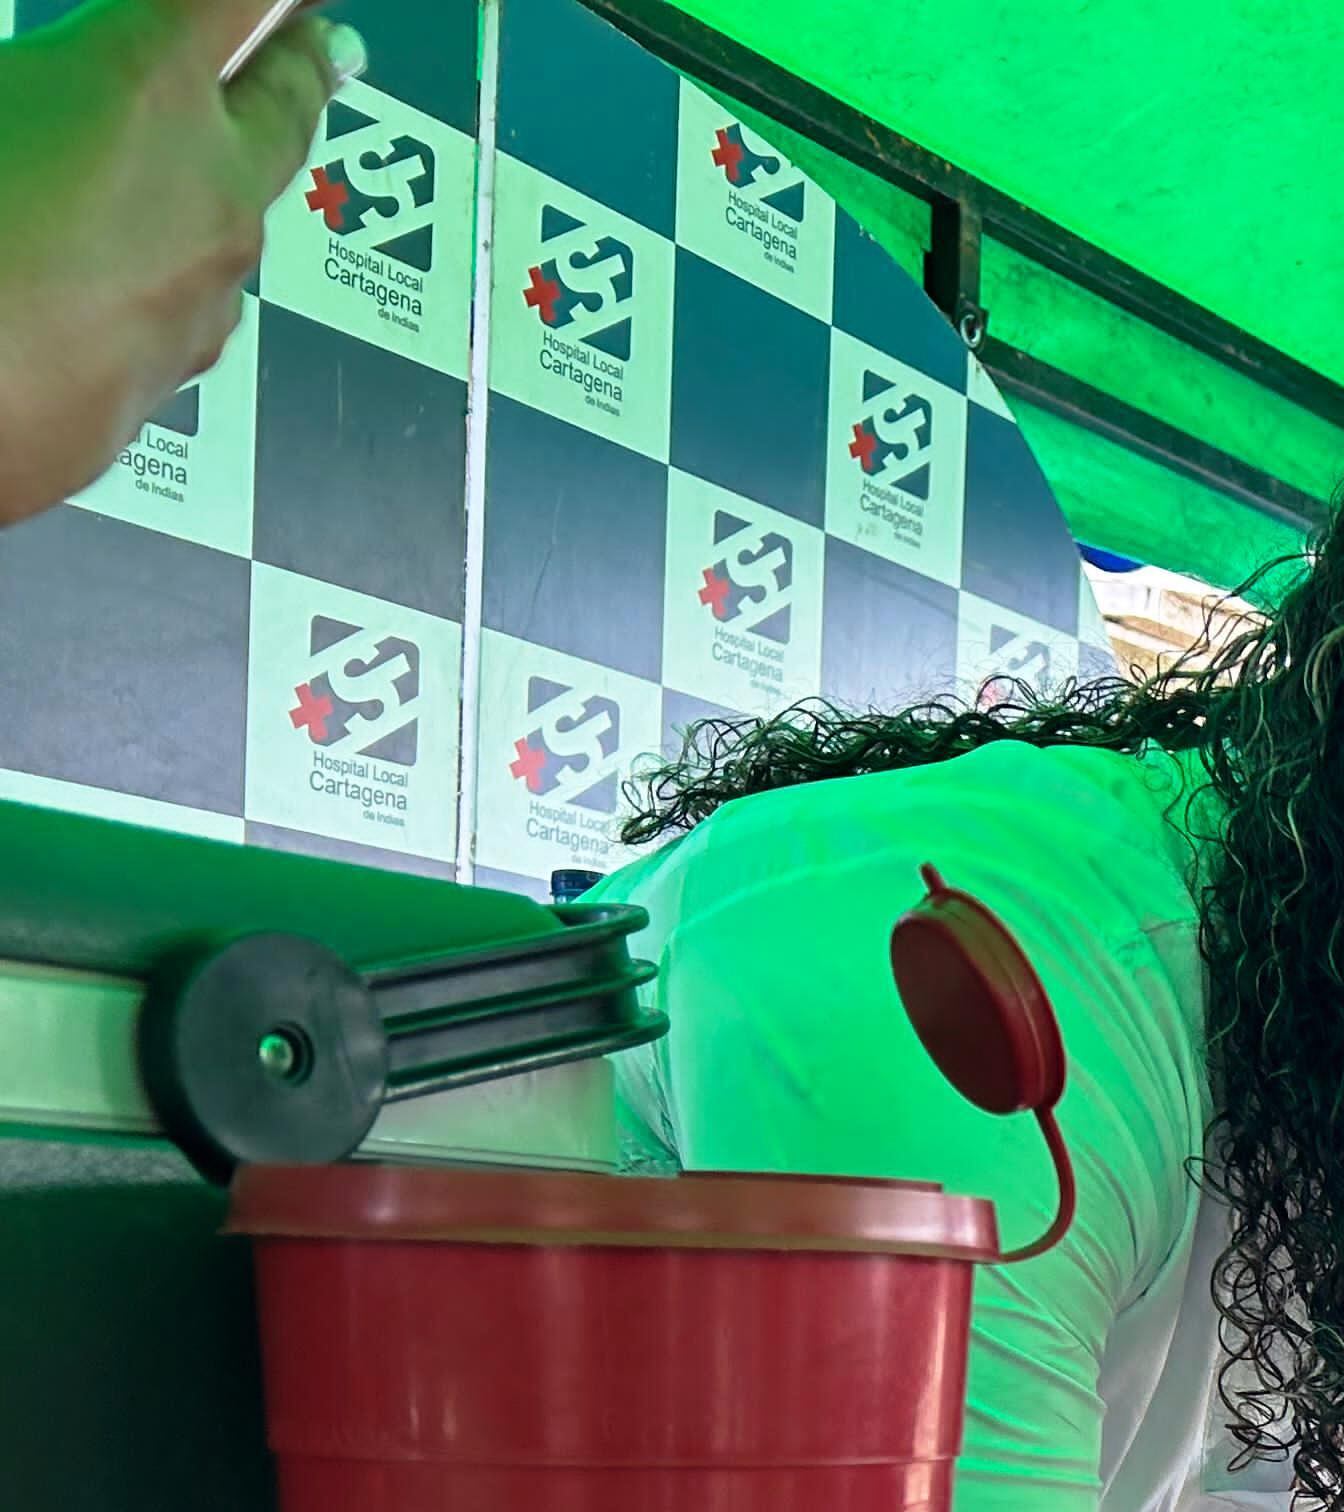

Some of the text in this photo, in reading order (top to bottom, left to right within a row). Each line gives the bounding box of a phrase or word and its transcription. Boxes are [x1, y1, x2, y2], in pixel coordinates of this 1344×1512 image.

[725, 206, 797, 260] Cartagena
[729, 190, 798, 240] Hospital Local
[324, 257, 422, 316] Cartagena
[328, 236, 423, 293] Hospital Local
[540, 349, 622, 402] Cartagena
[543, 330, 624, 380] Hospital Local
[113, 447, 188, 485] agena
[146, 428, 188, 459] Local
[309, 769, 407, 811] Cartagena
[313, 749, 408, 788] Hospital Local
[526, 817, 609, 855] Cartagena
